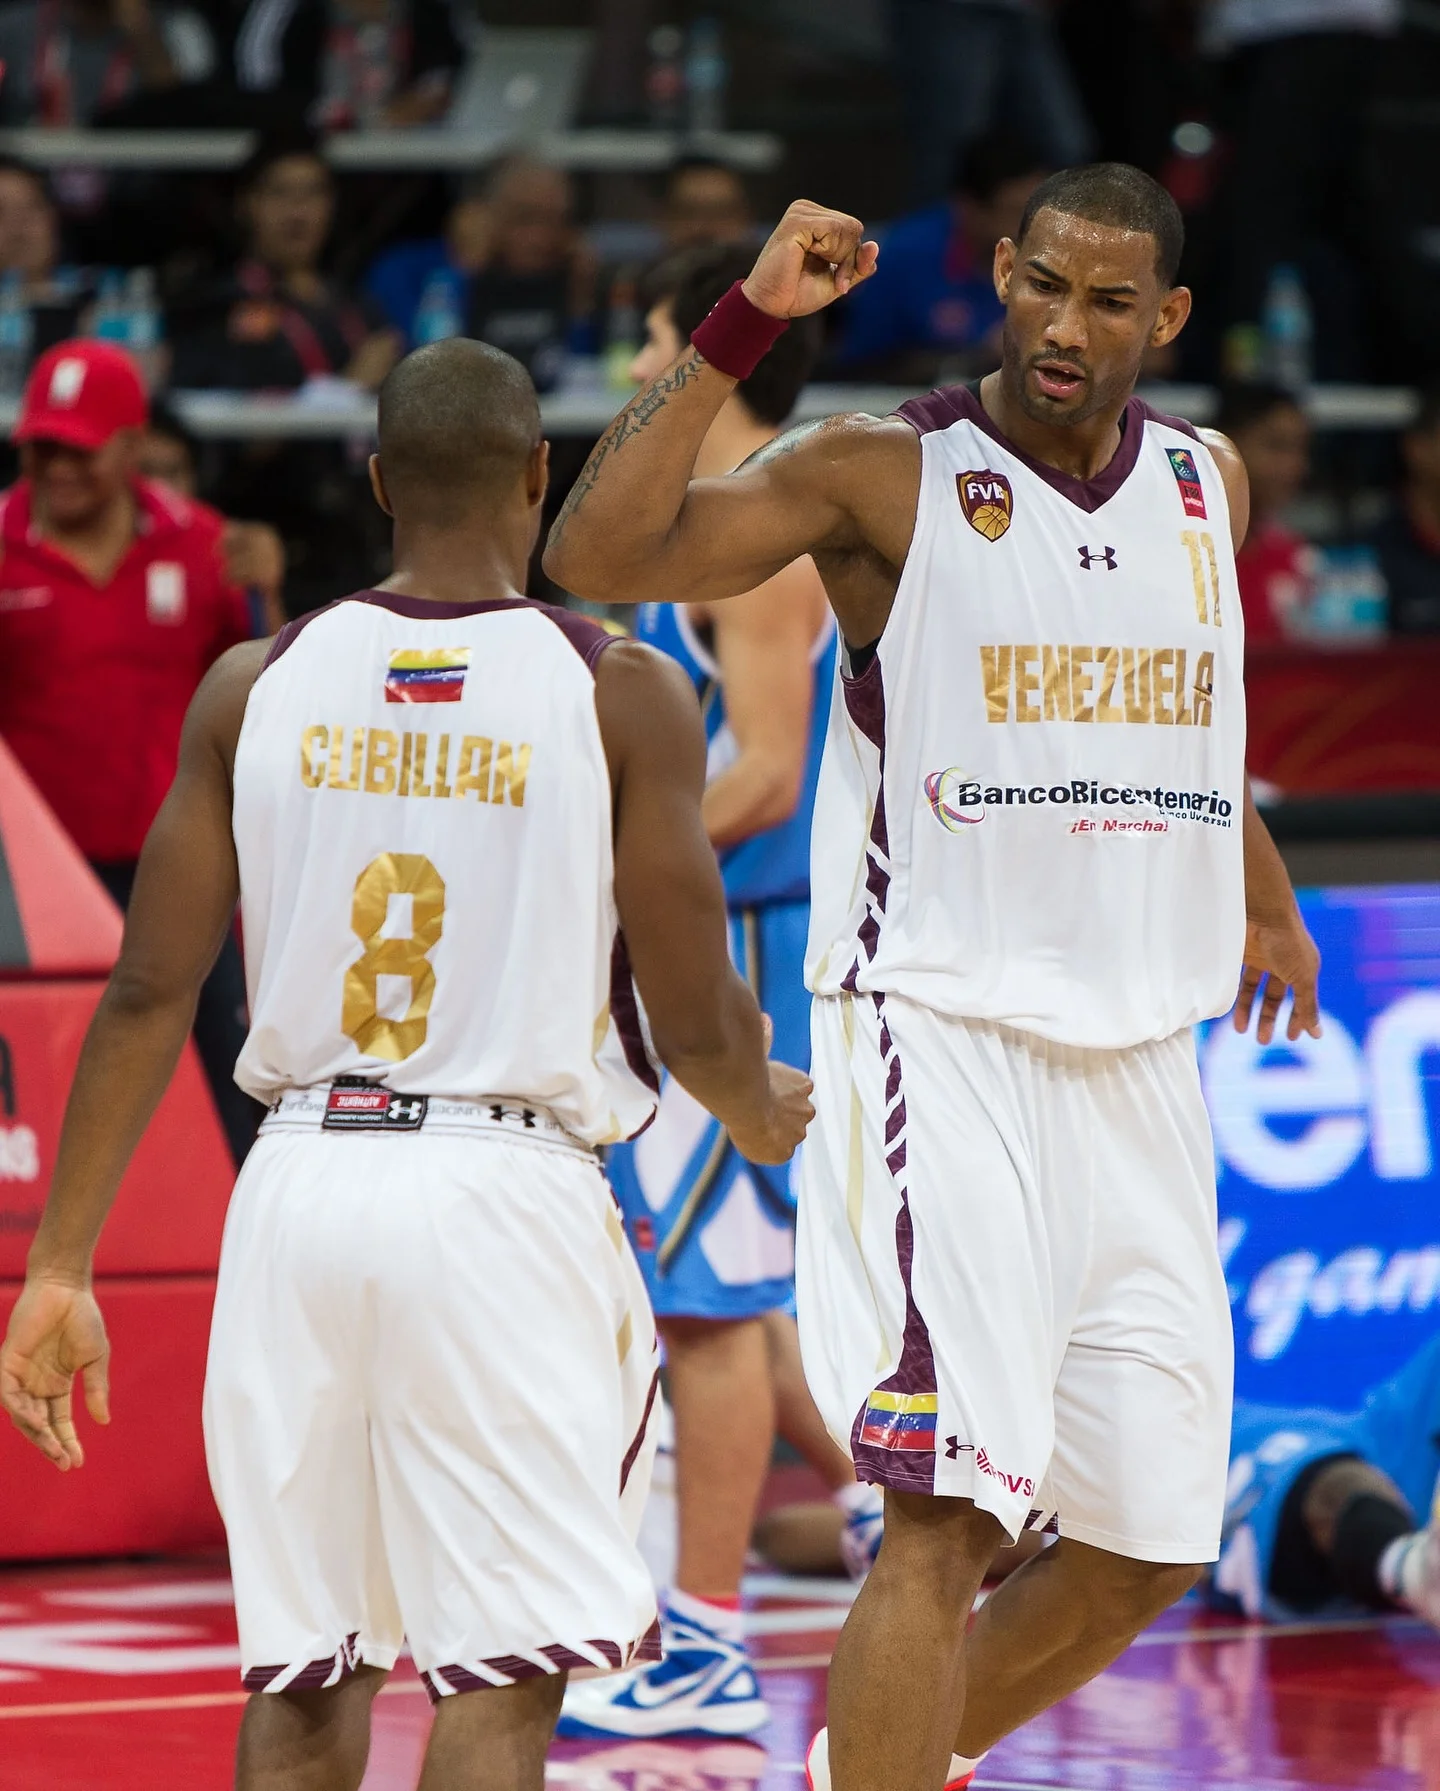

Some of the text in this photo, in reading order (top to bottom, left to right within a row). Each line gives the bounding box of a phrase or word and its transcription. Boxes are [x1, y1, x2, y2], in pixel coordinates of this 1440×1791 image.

[979, 645, 1214, 728] VENEZUELA
[300, 724, 532, 807] CUBILLAN
[341, 852, 445, 1062] 8
[990, 1464, 1036, 1497] DVS
